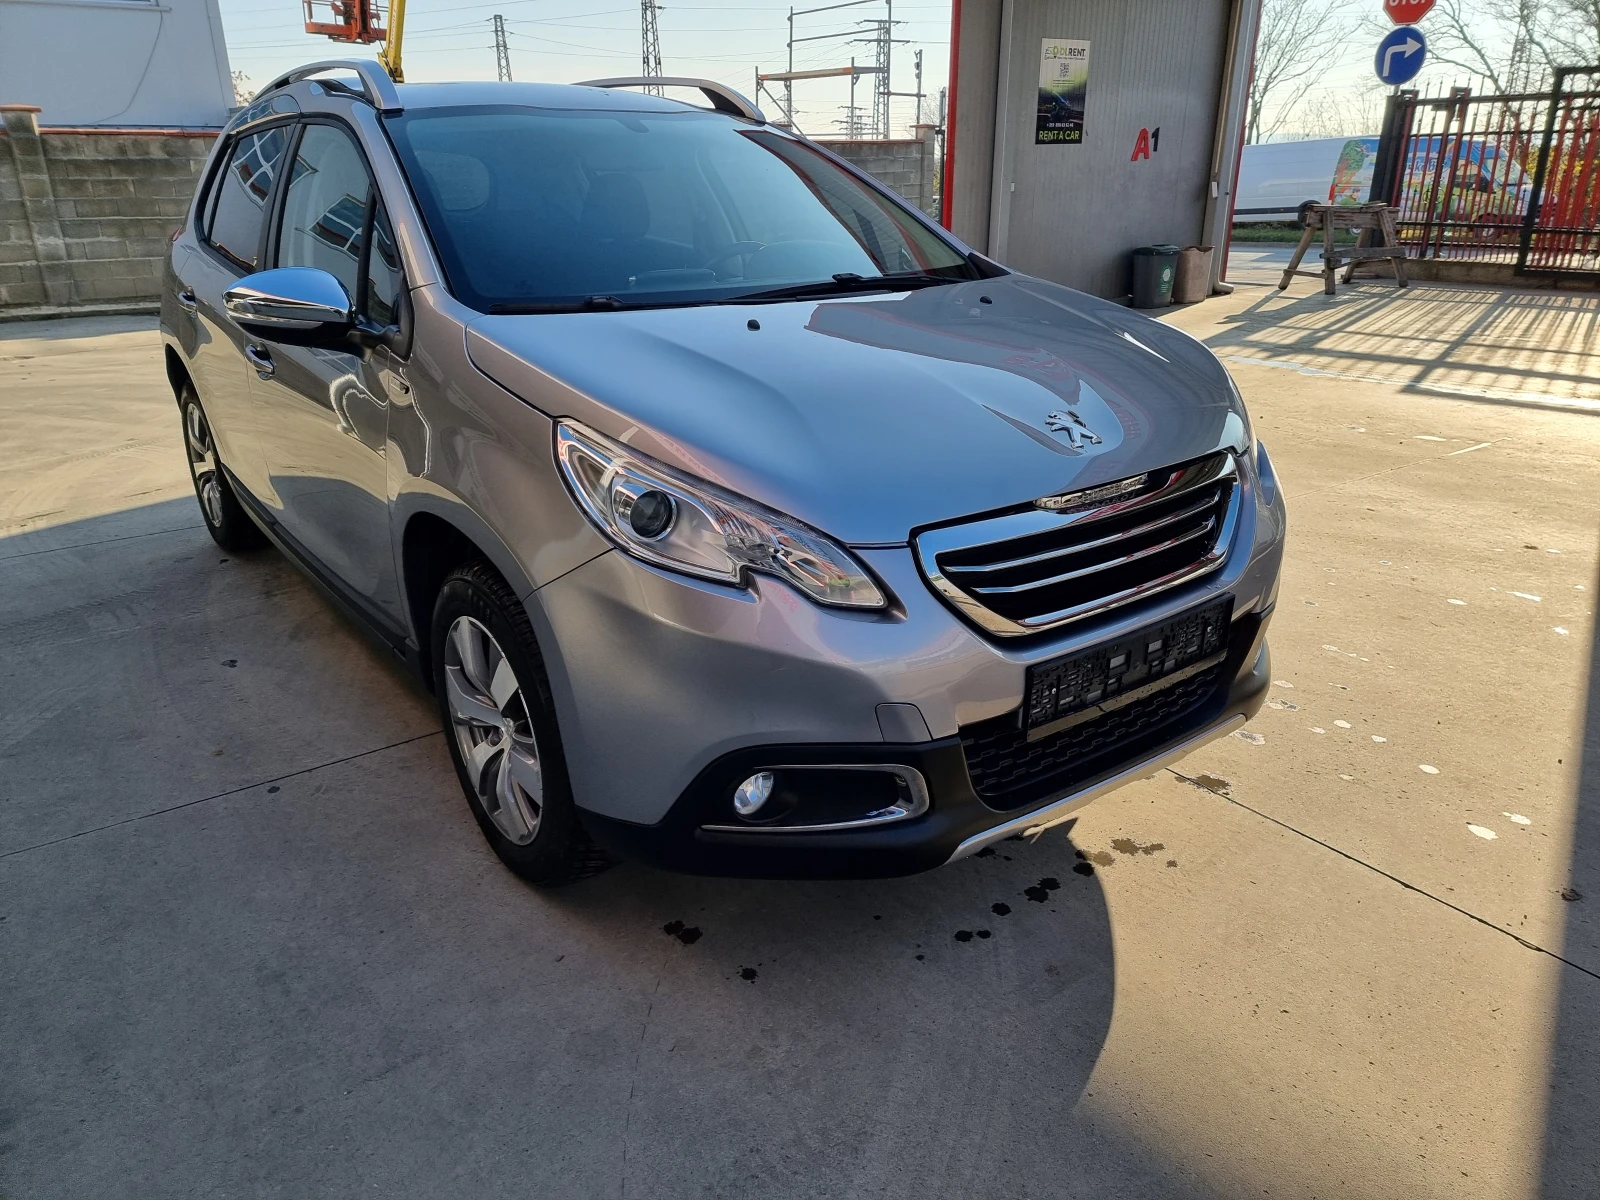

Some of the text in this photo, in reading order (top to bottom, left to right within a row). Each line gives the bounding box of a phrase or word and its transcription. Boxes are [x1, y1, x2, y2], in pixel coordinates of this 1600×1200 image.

[1039, 130, 1079, 140] RENT A CAR
[1131, 127, 1160, 162] A1
